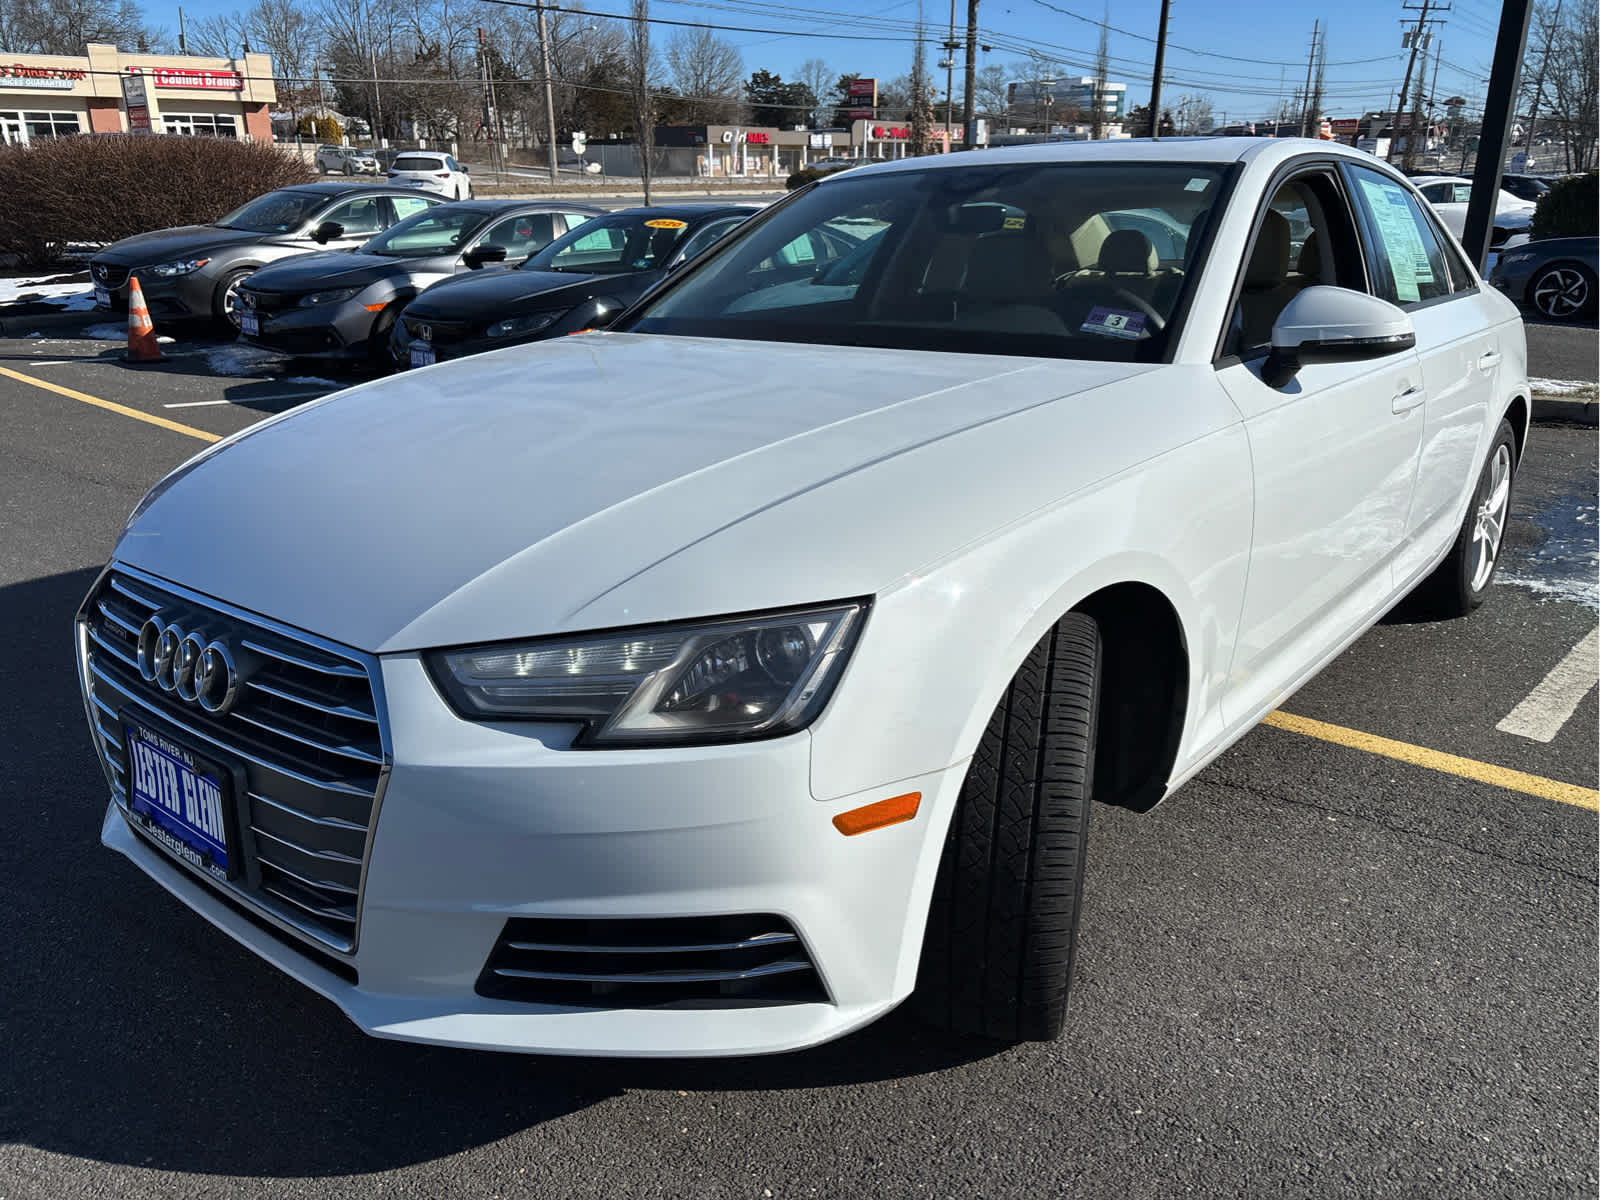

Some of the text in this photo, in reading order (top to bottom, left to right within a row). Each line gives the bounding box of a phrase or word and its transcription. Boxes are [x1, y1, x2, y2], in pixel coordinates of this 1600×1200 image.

[160, 70, 203, 86] Cabinet
[1111, 316, 1122, 326] 3
[138, 726, 159, 746] TOMS
[183, 751, 195, 767] NJ
[130, 738, 227, 846] LESTER GLENN
